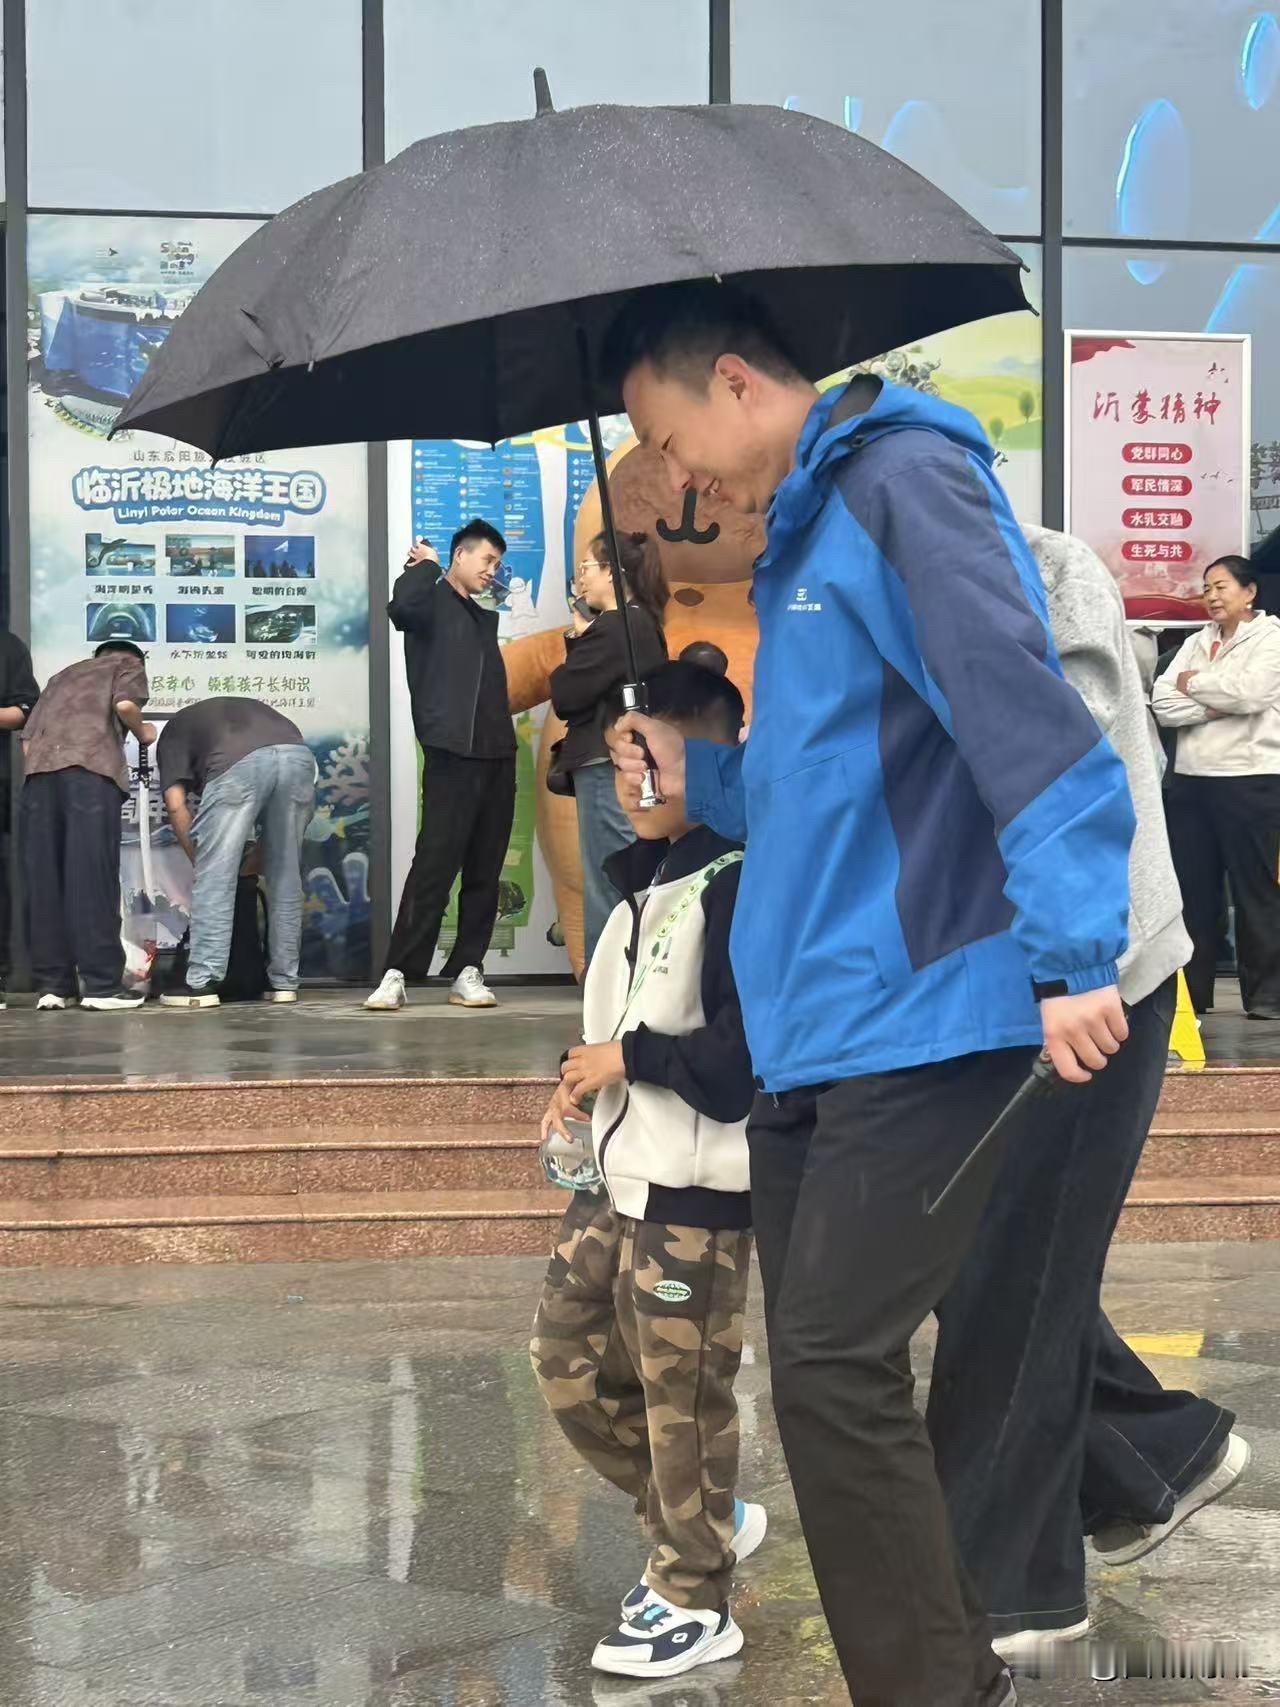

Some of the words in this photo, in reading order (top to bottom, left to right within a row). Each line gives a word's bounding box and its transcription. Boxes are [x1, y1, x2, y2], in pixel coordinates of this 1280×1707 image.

[1093, 390, 1221, 425] 沂蒙精神
[1131, 447, 1183, 461] 党群同心
[76, 470, 323, 508] 临沂极地海洋王国
[1131, 478, 1183, 493] 军民情深
[151, 506, 183, 516] Polar
[187, 505, 226, 516] Ocean
[229, 506, 281, 522] Kingdom
[1130, 512, 1183, 527] 水乳交融
[1131, 544, 1183, 558] 生死与共
